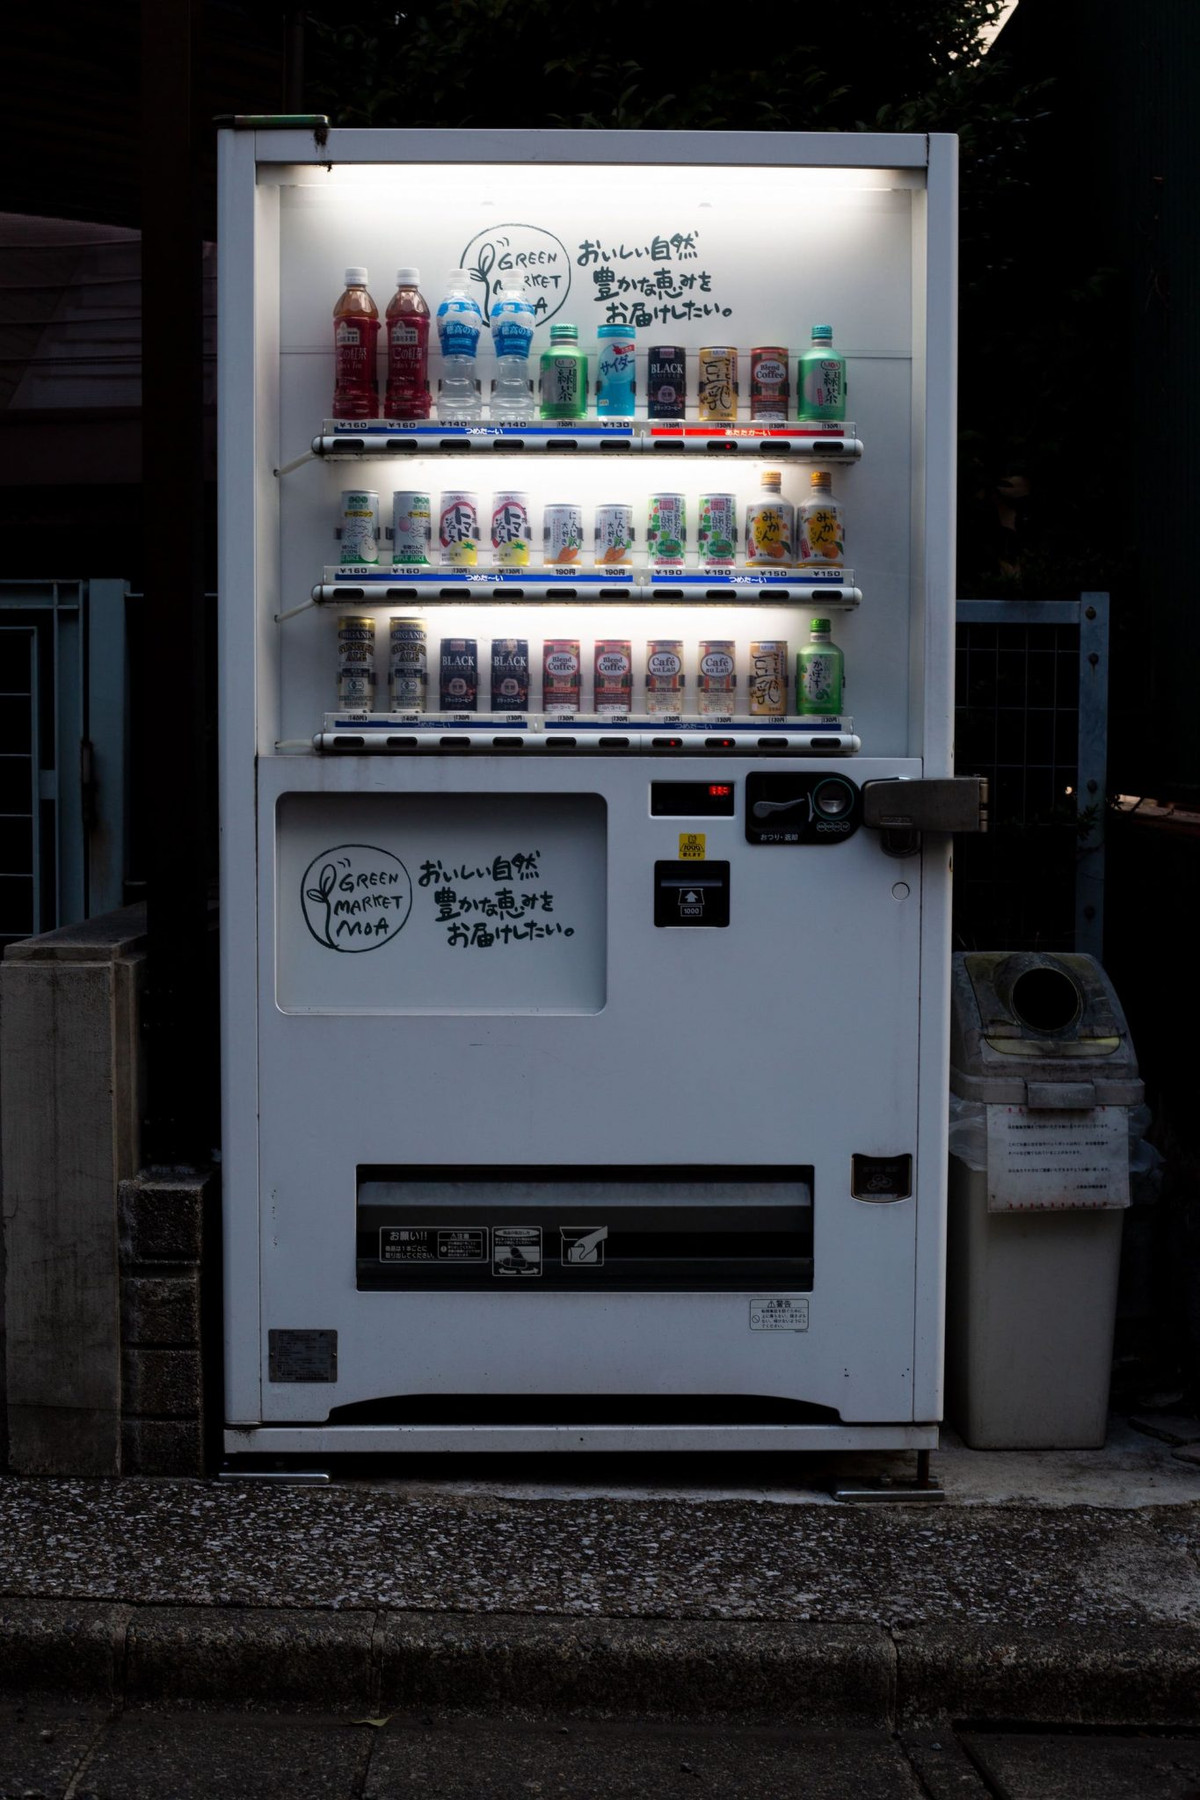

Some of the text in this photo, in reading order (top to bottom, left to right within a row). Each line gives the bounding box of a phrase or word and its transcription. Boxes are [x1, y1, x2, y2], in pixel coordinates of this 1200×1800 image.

[577, 231, 699, 266] おいしい自然
[498, 252, 557, 270] GREEN
[493, 274, 562, 295] MRKET
[593, 266, 712, 301] 豊かな恵みを
[606, 299, 732, 327] お届けしたい。
[600, 354, 635, 376] サイダー
[651, 363, 683, 374] BLACK
[756, 370, 784, 379] Coffee
[760, 363, 780, 371] Blend
[445, 518, 456, 543] ジュース
[455, 506, 471, 541] トマト
[496, 518, 506, 543] ジュース
[504, 506, 521, 542] トマト
[442, 656, 474, 666] BLACK
[494, 656, 526, 666] BLACK
[548, 662, 576, 671] Coffee
[599, 663, 627, 671] Coffee
[652, 657, 675, 666] Café
[705, 657, 729, 667] Café
[418, 850, 541, 887] おいしい自然
[339, 872, 399, 891] GREEN
[334, 894, 403, 916] MARKET
[434, 887, 554, 922] 豊かな恵みを
[336, 917, 389, 937] MOA
[447, 920, 575, 948] お届けしたい。
